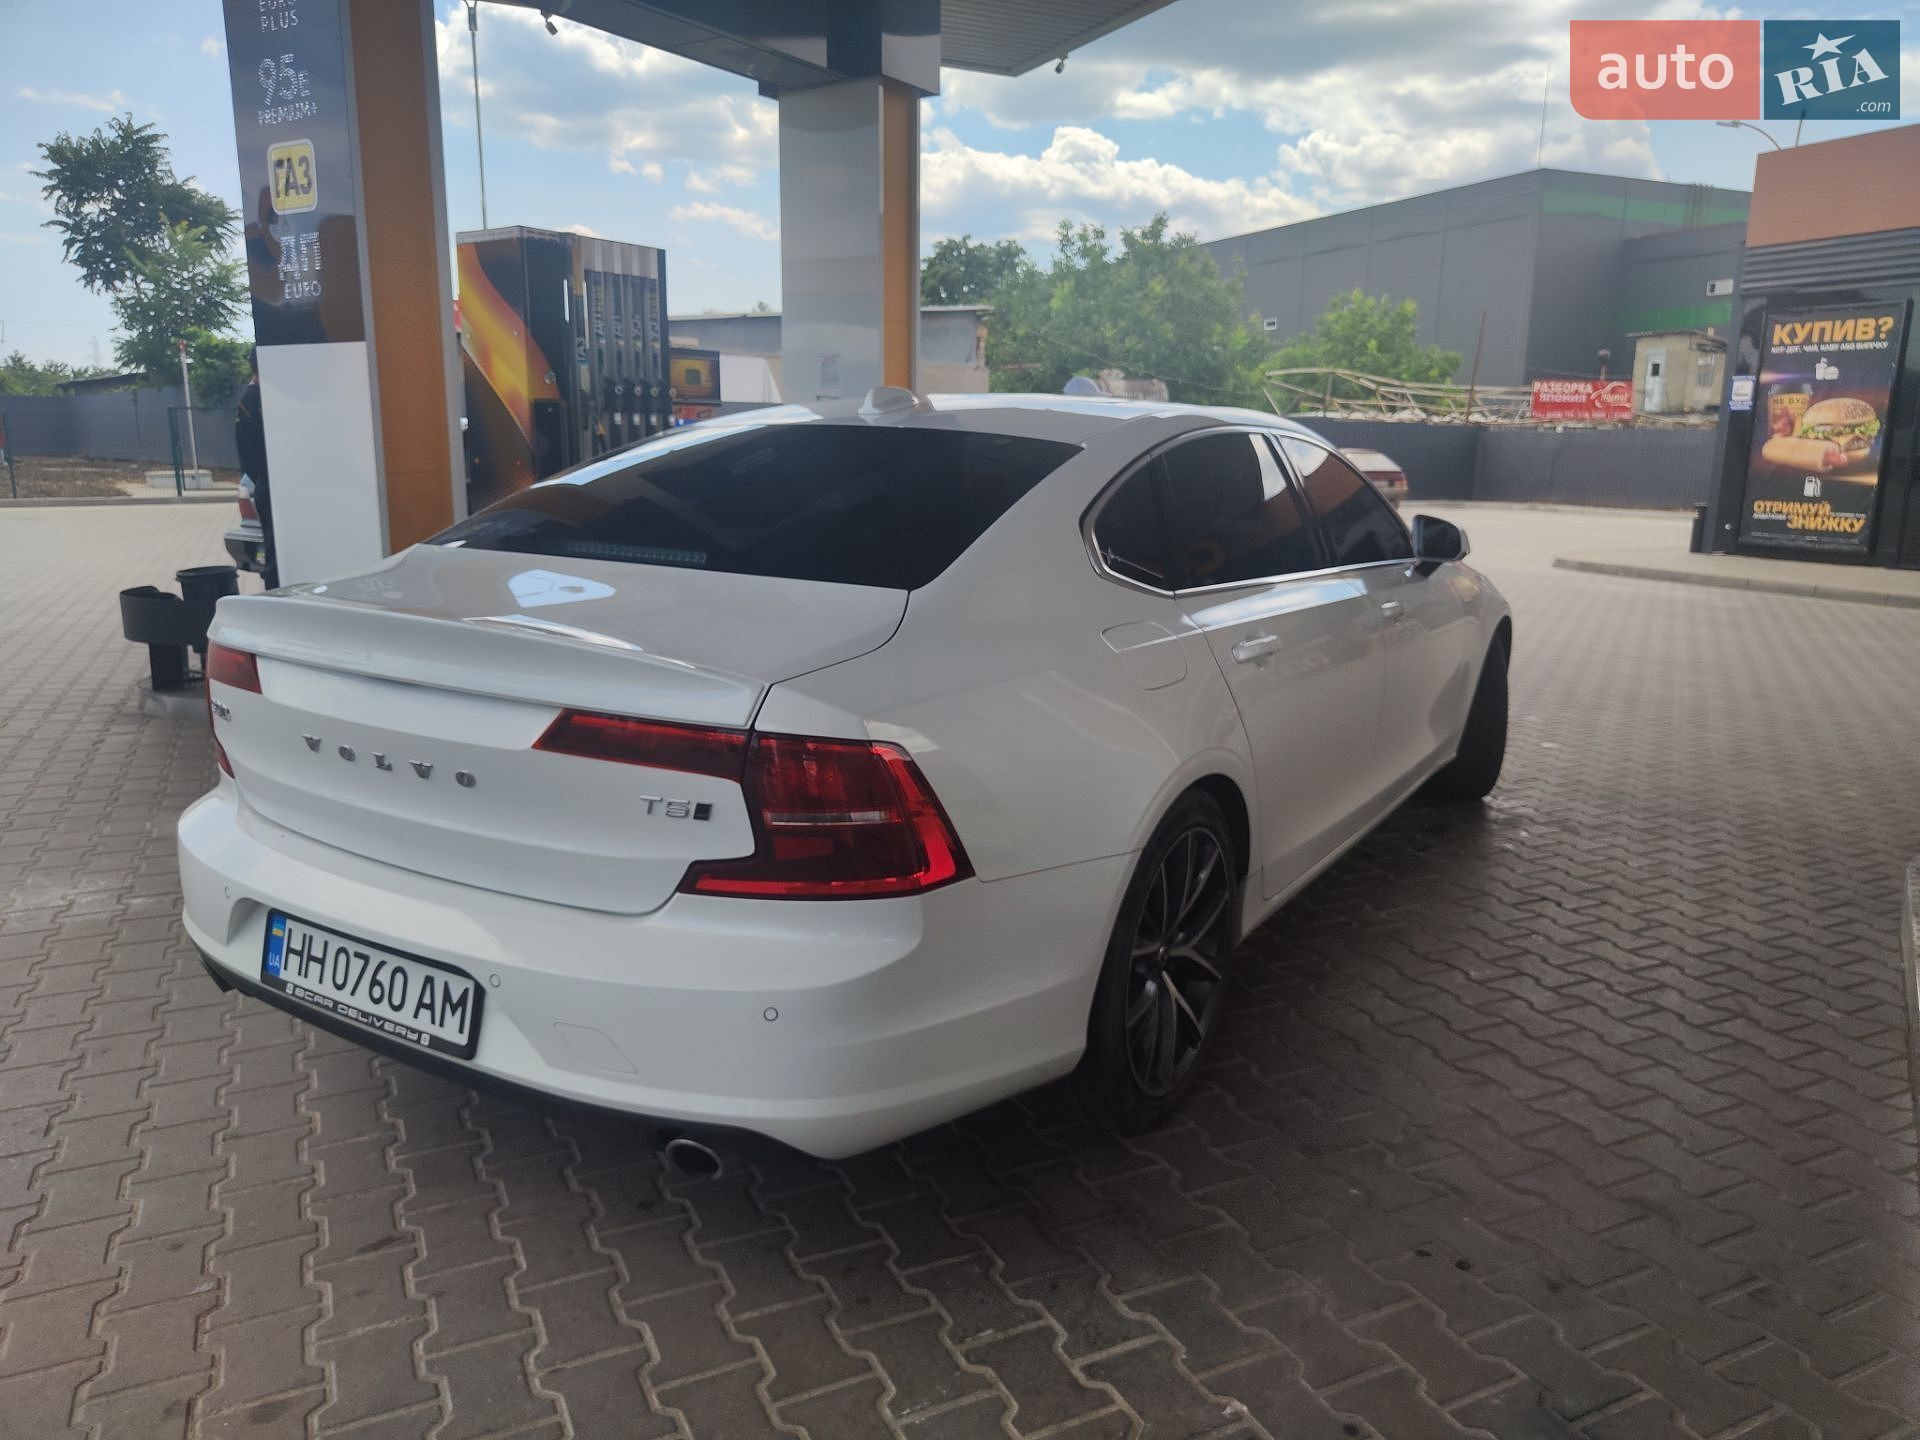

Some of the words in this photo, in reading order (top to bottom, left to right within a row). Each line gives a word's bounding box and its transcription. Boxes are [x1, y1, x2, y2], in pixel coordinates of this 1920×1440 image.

[260, 9, 299, 32] PLUS
[273, 155, 312, 199] ГАЗ
[285, 281, 321, 299] EURO
[1772, 316, 1894, 346] КУПИВ?
[1753, 500, 1831, 515] ОТРИМУЙ
[1787, 514, 1866, 533] ЗНИЖКУ
[301, 733, 477, 788] VOLVO
[268, 951, 280, 969] UA
[337, 1003, 419, 1042] DELIVERY
